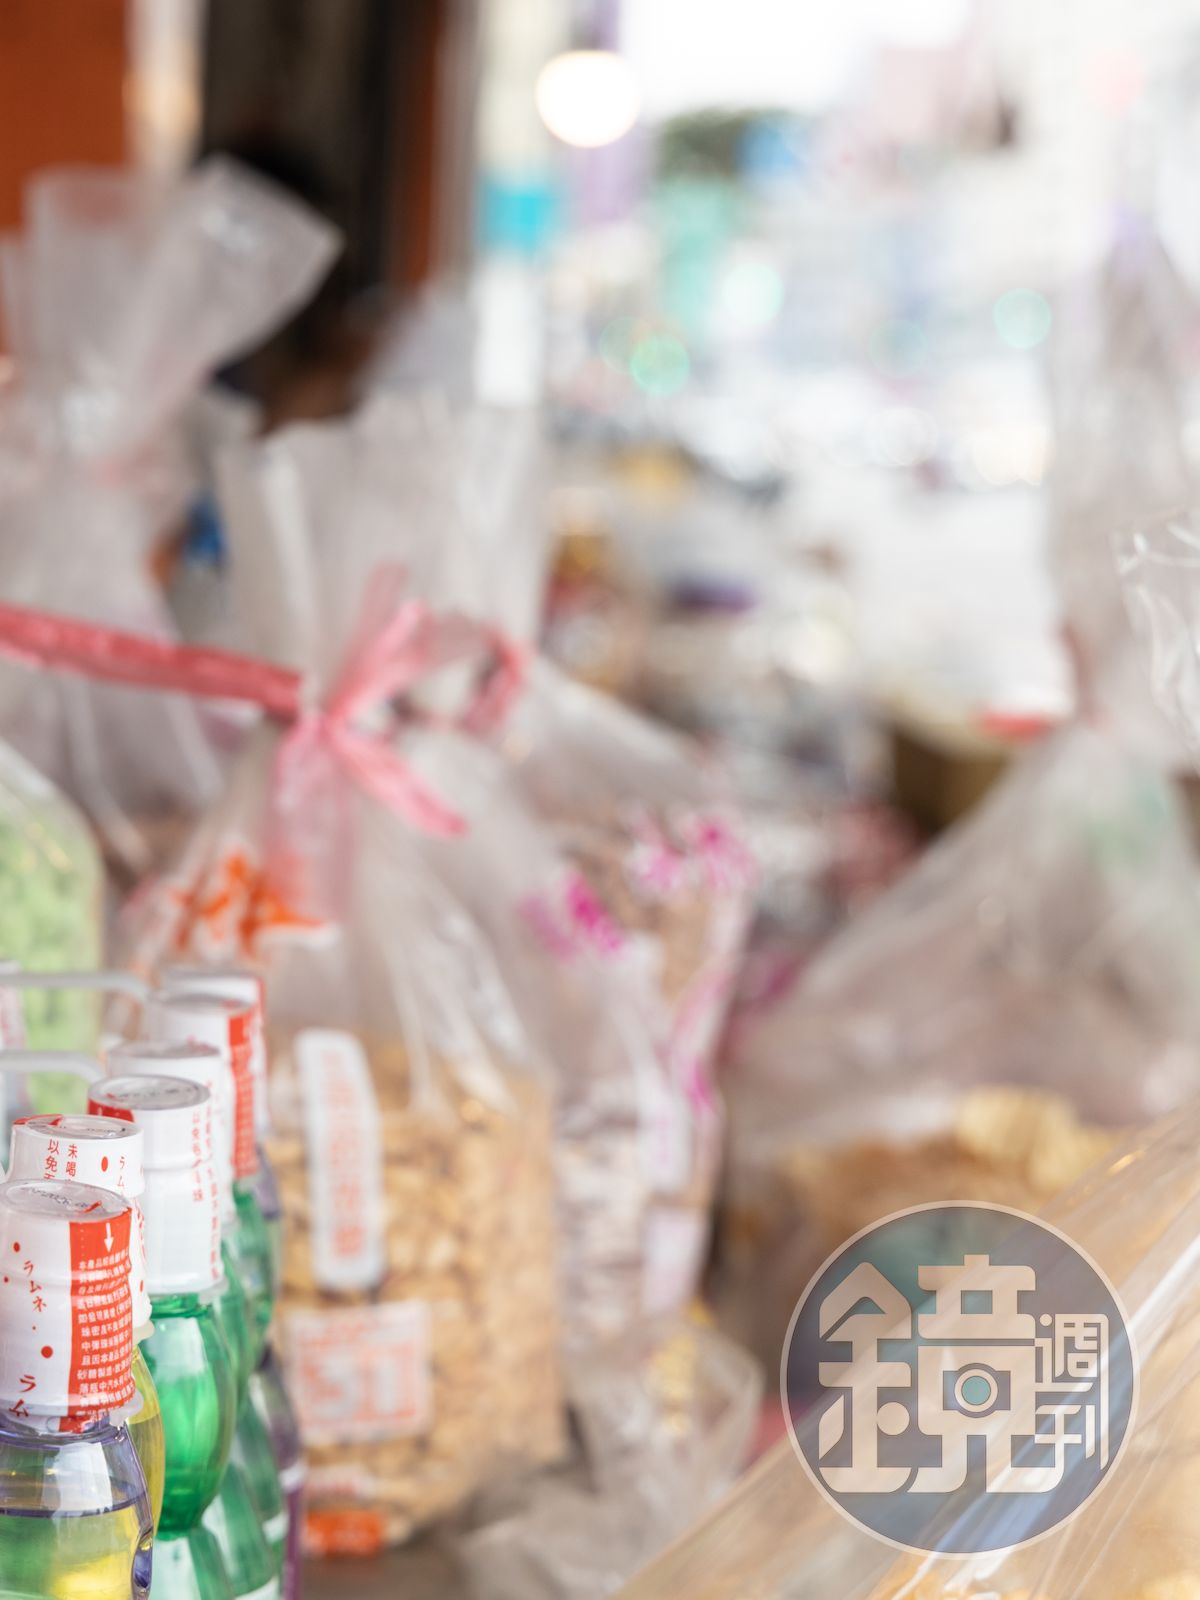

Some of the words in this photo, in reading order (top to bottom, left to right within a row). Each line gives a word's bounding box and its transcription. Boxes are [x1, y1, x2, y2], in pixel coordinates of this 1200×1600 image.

[65, 1144, 78, 1183] 未喝
[24, 1260, 47, 1312] ラムネ
